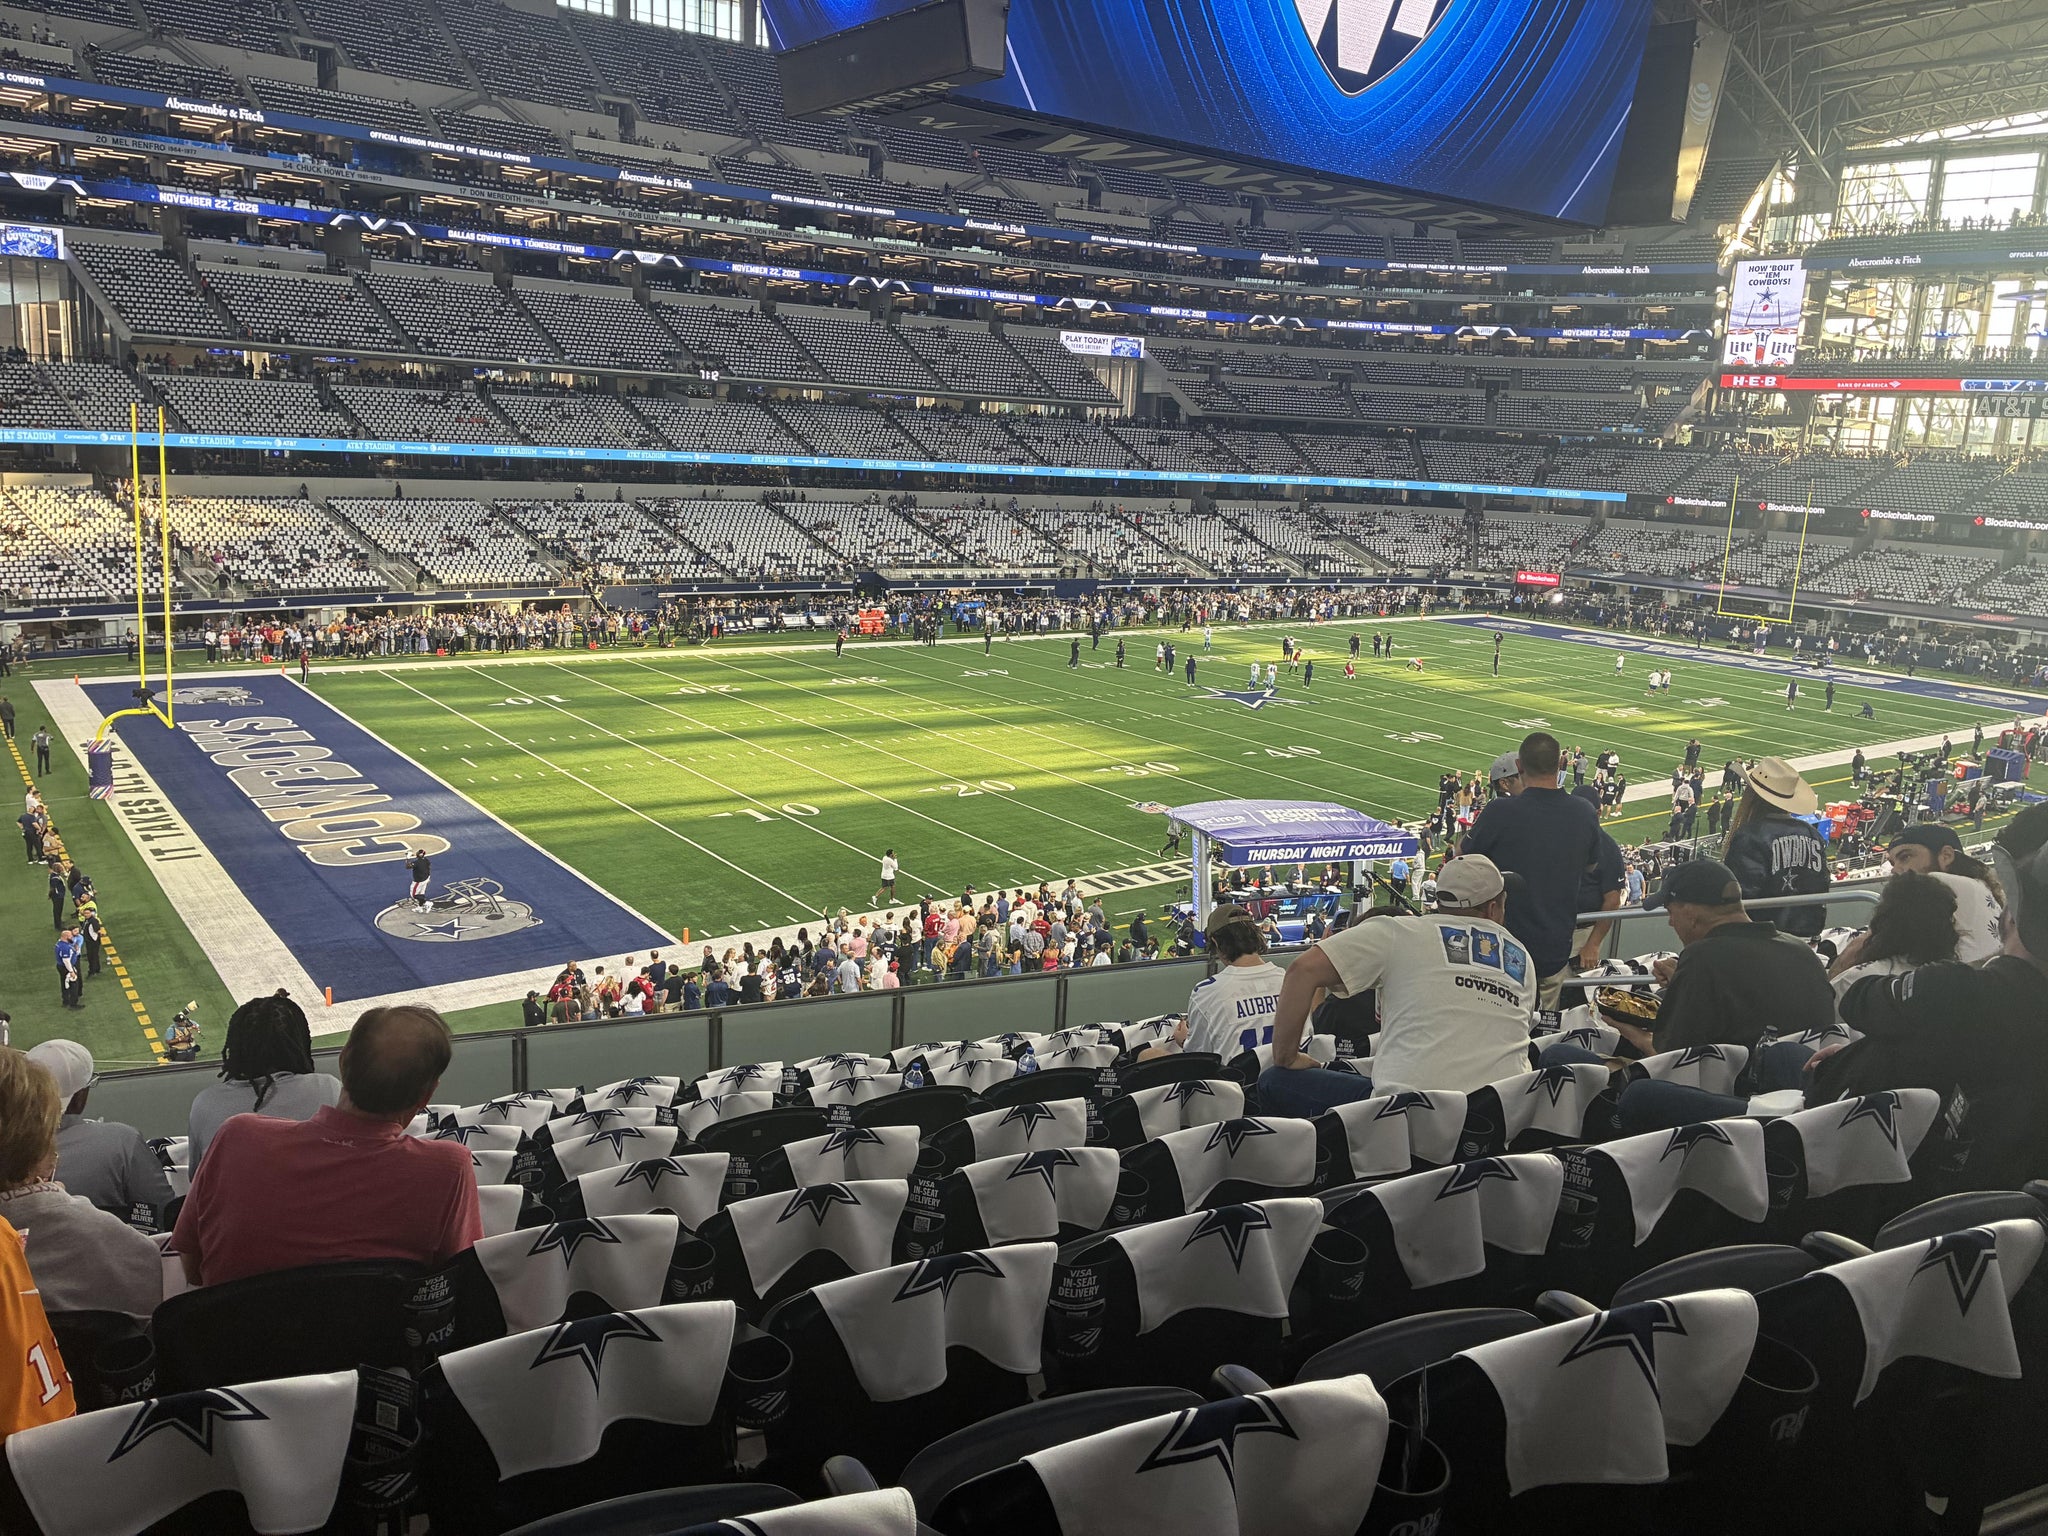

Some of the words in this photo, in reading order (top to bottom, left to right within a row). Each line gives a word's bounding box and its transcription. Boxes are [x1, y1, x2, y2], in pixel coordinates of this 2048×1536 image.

[7, 73, 46, 86] COWBOYS
[821, 81, 961, 116] WINSTAR
[165, 97, 228, 117] Abercrombie
[238, 108, 264, 123] Fitch
[95, 135, 108, 144] 20
[112, 137, 130, 147] MEL
[132, 139, 166, 152] RENFRO
[369, 131, 399, 142] OFFICIAL
[400, 133, 427, 147] FASHION
[427, 140, 455, 151] PARTNER
[479, 149, 502, 159] DALLAS
[502, 153, 531, 163] COWBOYS
[282, 161, 293, 170] 54
[296, 163, 322, 174] CHUCK
[323, 167, 356, 179] HOWLEY
[619, 170, 665, 186] Abercrombie
[673, 178, 693, 190] Fitch
[1036, 133, 1501, 229] WINSTAR
[459, 187, 467, 195] 17
[470, 188, 485, 197] DON
[487, 191, 522, 202] MEREDITH
[159, 192, 213, 208] NOVEMBER
[214, 200, 231, 211] 22,
[233, 201, 259, 214] 2026
[617, 209, 626, 217] 74
[628, 210, 642, 219] BOB
[643, 213, 659, 221] LILLY
[965, 219, 1003, 232] Abercrombie
[1009, 224, 1026, 235] Fitch
[447, 229, 476, 241] DALLAS
[476, 233, 510, 245] COWBOYS
[524, 239, 562, 251] TENNESSEE
[562, 244, 585, 254] TITANS
[1260, 252, 1297, 264] Abercrombie
[1303, 256, 1319, 266] Fitch
[1848, 257, 1894, 267] Abercrombie
[1902, 255, 1922, 265] Fitch
[2009, 251, 2034, 259] OFFICIAL
[732, 263, 768, 275] NOVEMBER
[782, 269, 800, 279] 2026
[1582, 265, 1625, 275] Abercrombie
[1632, 265, 1650, 274] Fitch
[1748, 265, 1769, 273] HOW
[1769, 264, 1795, 272] 'BOUT
[1748, 278, 1792, 287] COWBOYS!
[953, 287, 980, 297] COWBOYS
[1065, 335, 1082, 343] PLAY
[1083, 336, 1109, 345] TODAY!
[1562, 329, 1598, 338] NOVEMBER
[1729, 341, 1753, 356] Lite
[1770, 341, 1796, 356] Lite
[1976, 395, 2036, 417] AT&T
[16, 431, 56, 441] STADIUM
[179, 436, 199, 445] AT&T
[200, 437, 236, 446] STADIUM
[346, 442, 364, 450] AT&T
[364, 442, 396, 451] STADIUM
[493, 447, 509, 455] AT&T
[509, 447, 538, 456] STADIUM
[641, 451, 667, 460] STADIUM
[1674, 496, 1727, 508] Blockchain.com
[1767, 502, 1826, 516] Blockchain.com
[1870, 508, 1935, 522] Blockchain.com
[1526, 573, 1557, 583] Blockchain
[679, 684, 743, 695] 20
[503, 693, 572, 708] 10
[1383, 730, 1445, 745] 50
[1265, 744, 1324, 759] 40
[1108, 760, 1181, 777] 30
[176, 716, 451, 867] COWBOYS
[938, 777, 1018, 799] 20
[121, 796, 187, 842] TAKES
[738, 801, 823, 825] 10
[1197, 814, 1247, 829] prime
[150, 843, 202, 863] IT
[1247, 847, 1308, 862] THURSDAY
[1310, 844, 1346, 859] NIGHT
[1349, 842, 1403, 857] FOOTBALL
[1771, 834, 1823, 875] OWBOYS
[783, 973, 796, 985] 33
[1455, 976, 1520, 1008] COWBOYS
[831, 1114, 851, 1123] DELIVERY
[515, 1160, 538, 1170] DELIVERY
[728, 1161, 750, 1170] IN-SEAT
[1566, 1153, 1587, 1165] VISA
[726, 1167, 752, 1177] DELIVERY
[1562, 1161, 1592, 1178] N-SEAT
[918, 1178, 935, 1188] VISA
[1564, 1173, 1593, 1188] LIVERY
[913, 1185, 939, 1199] IN-SEAT
[910, 1194, 941, 1208] DELIVERY
[130, 1213, 154, 1224] DELIVERY
[132, 1207, 153, 1217] IN-SEAT
[1070, 1268, 1093, 1278] VISA
[417, 1280, 450, 1295] IN-SEAT
[424, 1274, 445, 1287] VISA
[1063, 1275, 1098, 1288] IN-SEAT
[412, 1287, 451, 1302] DELIVERY
[1058, 1285, 1100, 1298] DELIVERY
